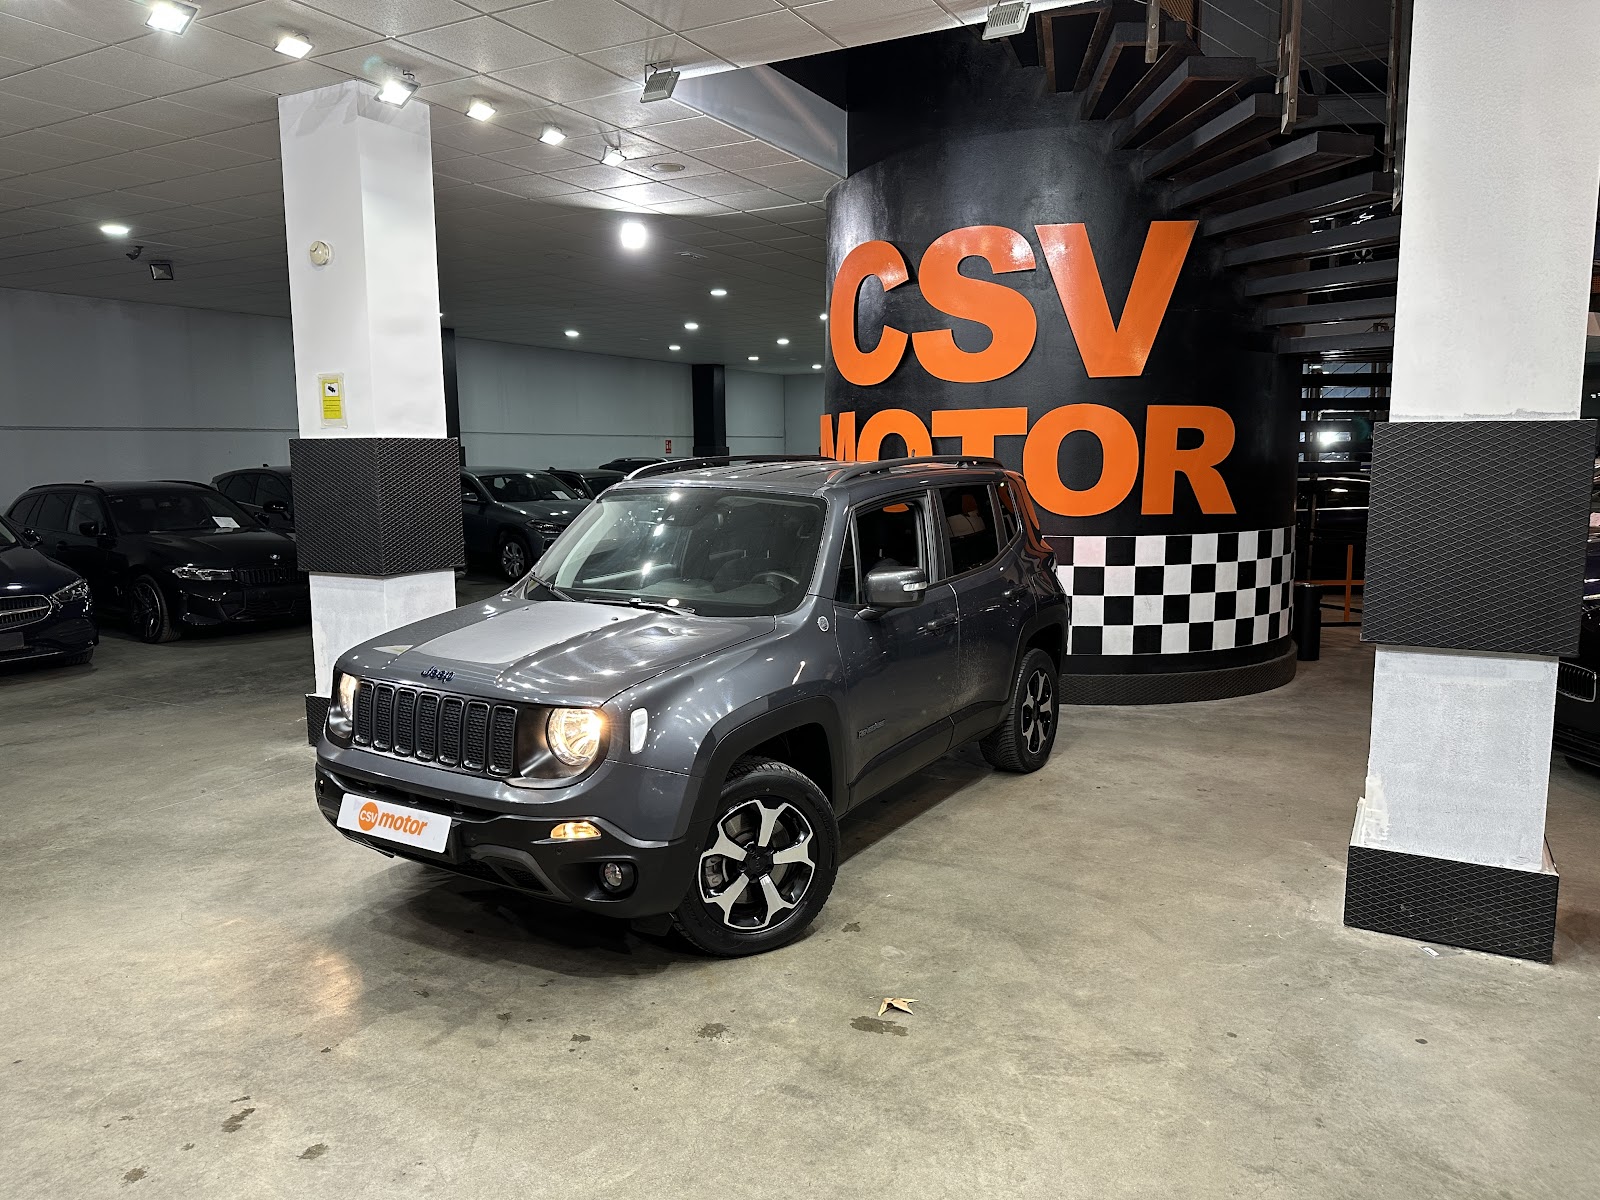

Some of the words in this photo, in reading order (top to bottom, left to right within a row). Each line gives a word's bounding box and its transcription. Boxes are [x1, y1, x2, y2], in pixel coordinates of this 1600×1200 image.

[830, 220, 1199, 386] CSV
[421, 666, 456, 684] Jeep
[378, 812, 428, 836] motor
